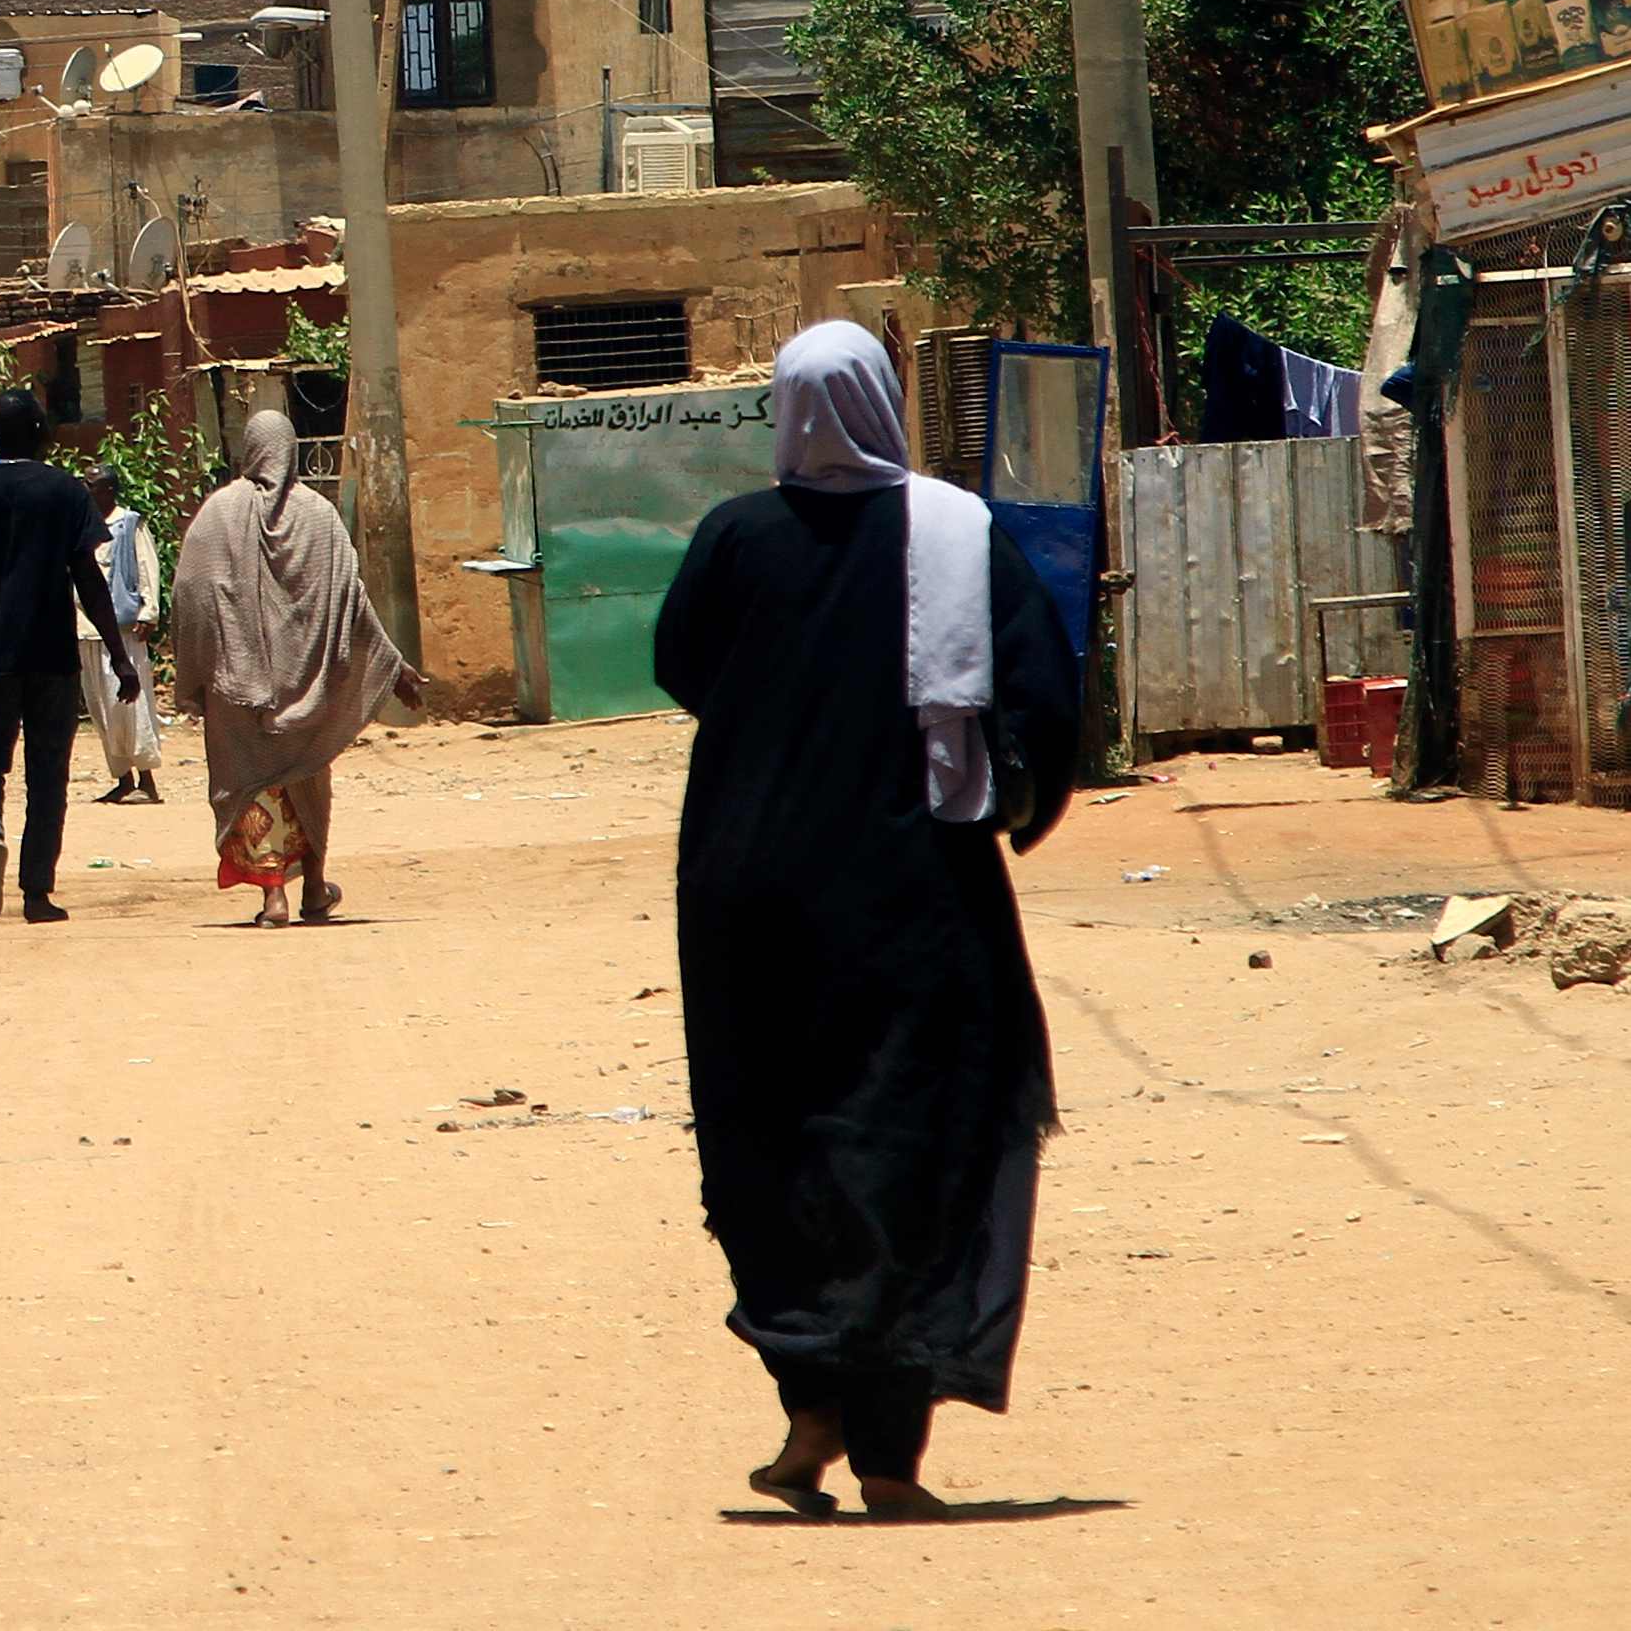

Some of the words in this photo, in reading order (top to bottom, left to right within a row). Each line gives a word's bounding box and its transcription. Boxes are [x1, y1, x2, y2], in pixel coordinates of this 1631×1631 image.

[1525, 151, 1599, 196] تحويل
[543, 404, 605, 431] للخدمات
[607, 402, 672, 432] الرازق
[680, 408, 721, 431] عبد
